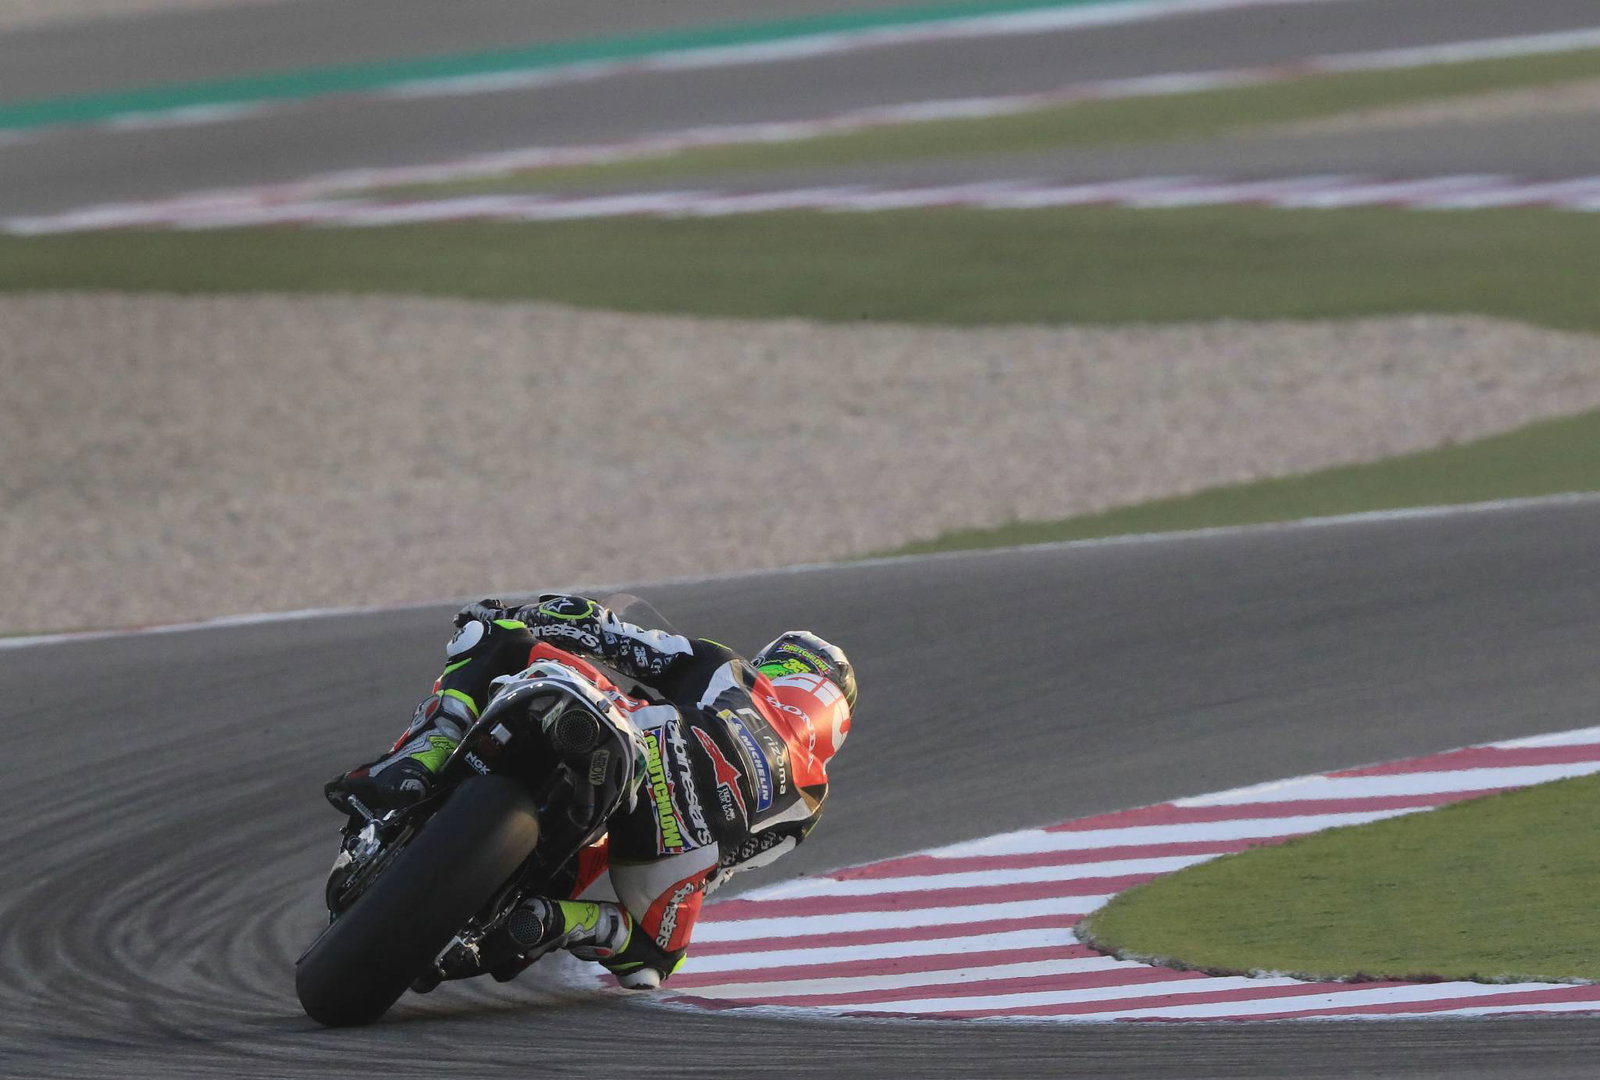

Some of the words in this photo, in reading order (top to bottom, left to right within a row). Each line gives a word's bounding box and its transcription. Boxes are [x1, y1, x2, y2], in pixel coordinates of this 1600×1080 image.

[528, 622, 599, 647] pinestars
[466, 751, 491, 775] NGK
[645, 734, 683, 847] CRUTCHLOW
[666, 721, 712, 844] alpinestars
[741, 736, 768, 801] MICHELIN
[763, 735, 787, 795] rizoma
